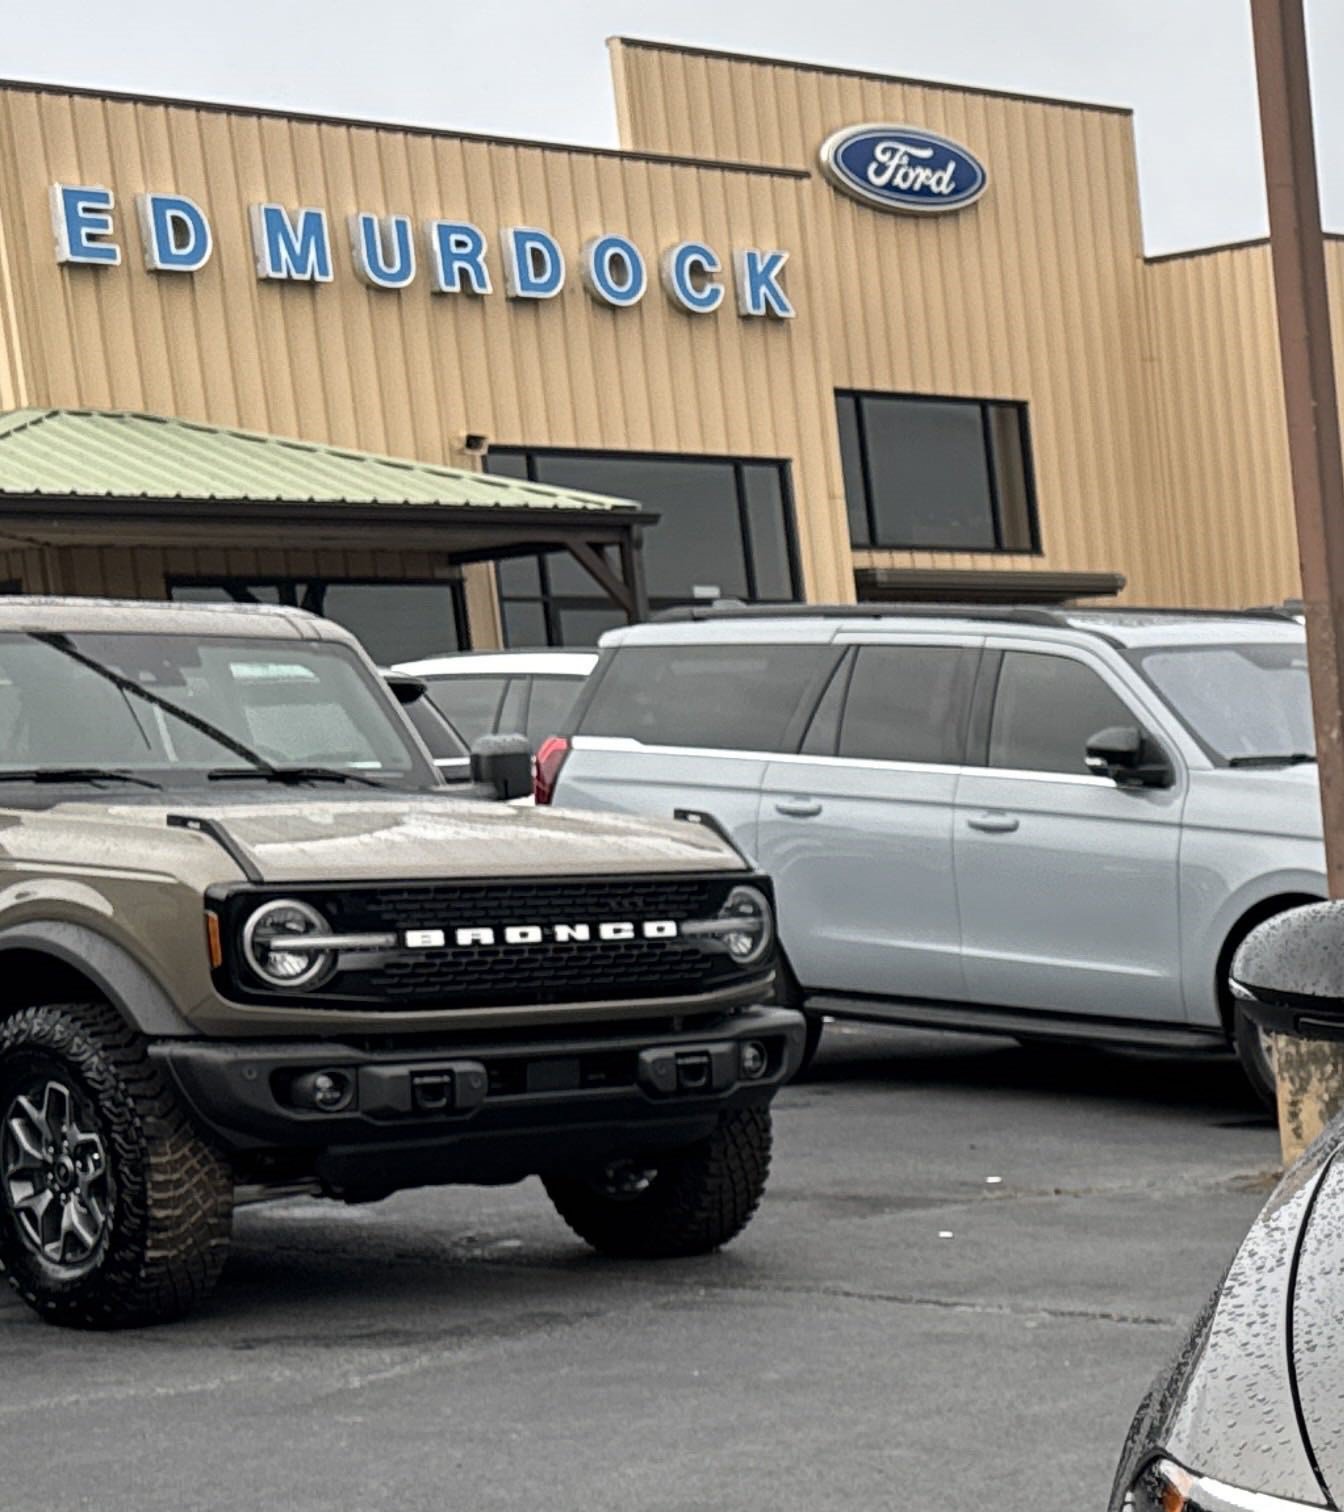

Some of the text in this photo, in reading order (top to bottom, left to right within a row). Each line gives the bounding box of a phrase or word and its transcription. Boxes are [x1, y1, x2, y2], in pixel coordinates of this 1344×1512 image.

[867, 141, 956, 195] Ford
[50, 182, 796, 319] ED MURDOCK
[405, 921, 678, 948] BRONCO
